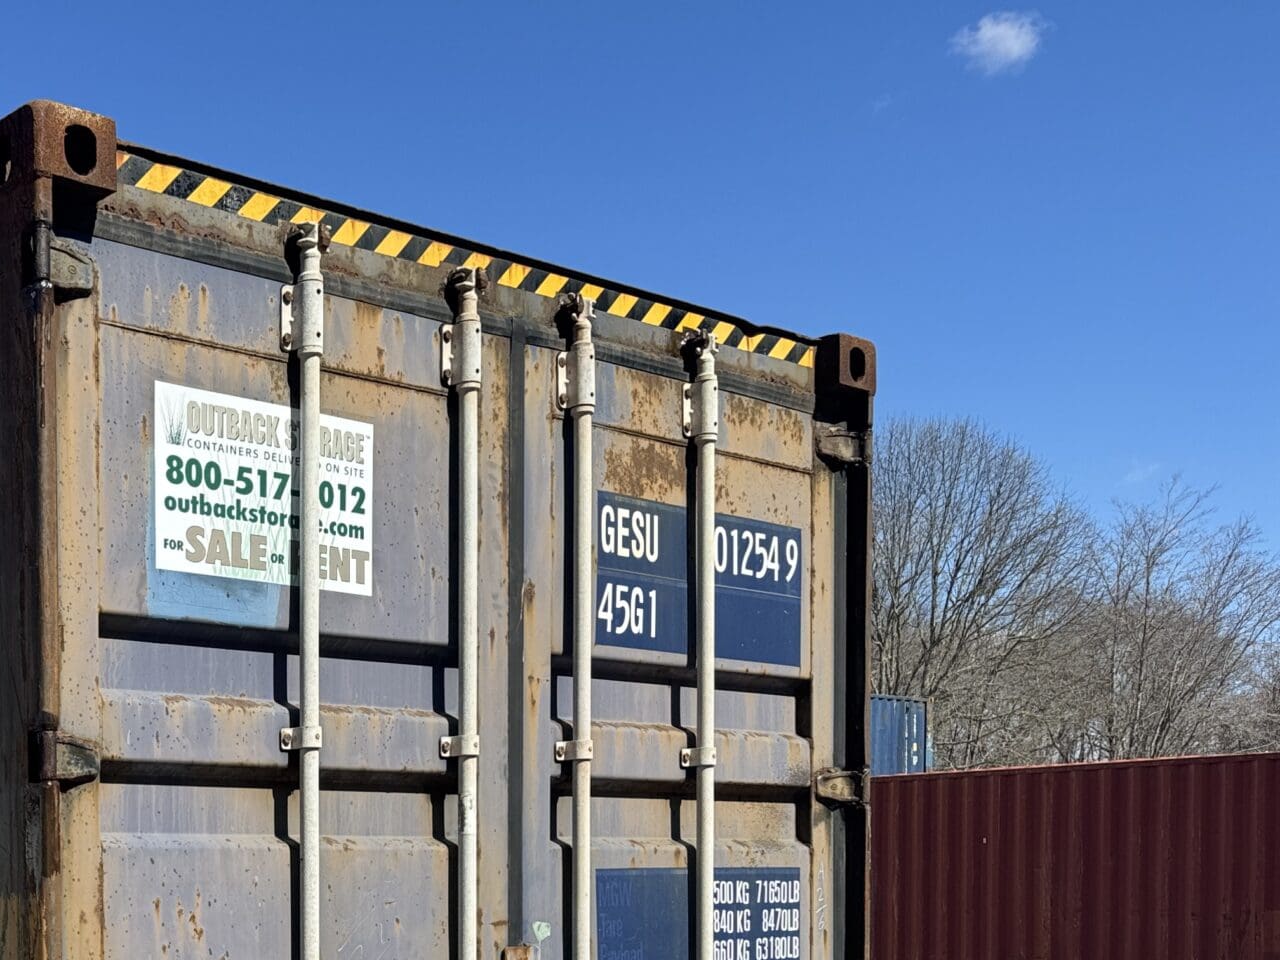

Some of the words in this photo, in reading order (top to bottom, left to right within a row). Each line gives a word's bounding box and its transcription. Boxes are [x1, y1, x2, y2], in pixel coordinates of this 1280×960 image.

[186, 400, 281, 450] OUTBACK
[284, 421, 365, 465] SRAGE
[187, 437, 259, 459] CONTAINERS
[325, 462, 340, 475] ON
[344, 464, 365, 479] SITE
[165, 454, 366, 516] 800-517-012
[163, 538, 184, 552] FOR
[185, 525, 268, 571] SALE
[270, 552, 285, 565] OR
[601, 505, 659, 563] GESU
[714, 526, 780, 582] 01254
[598, 582, 656, 638] 45G1
[714, 880, 734, 905] 500
[735, 880, 750, 905] KG
[714, 909, 734, 934] 840
[736, 908, 751, 934] KG
